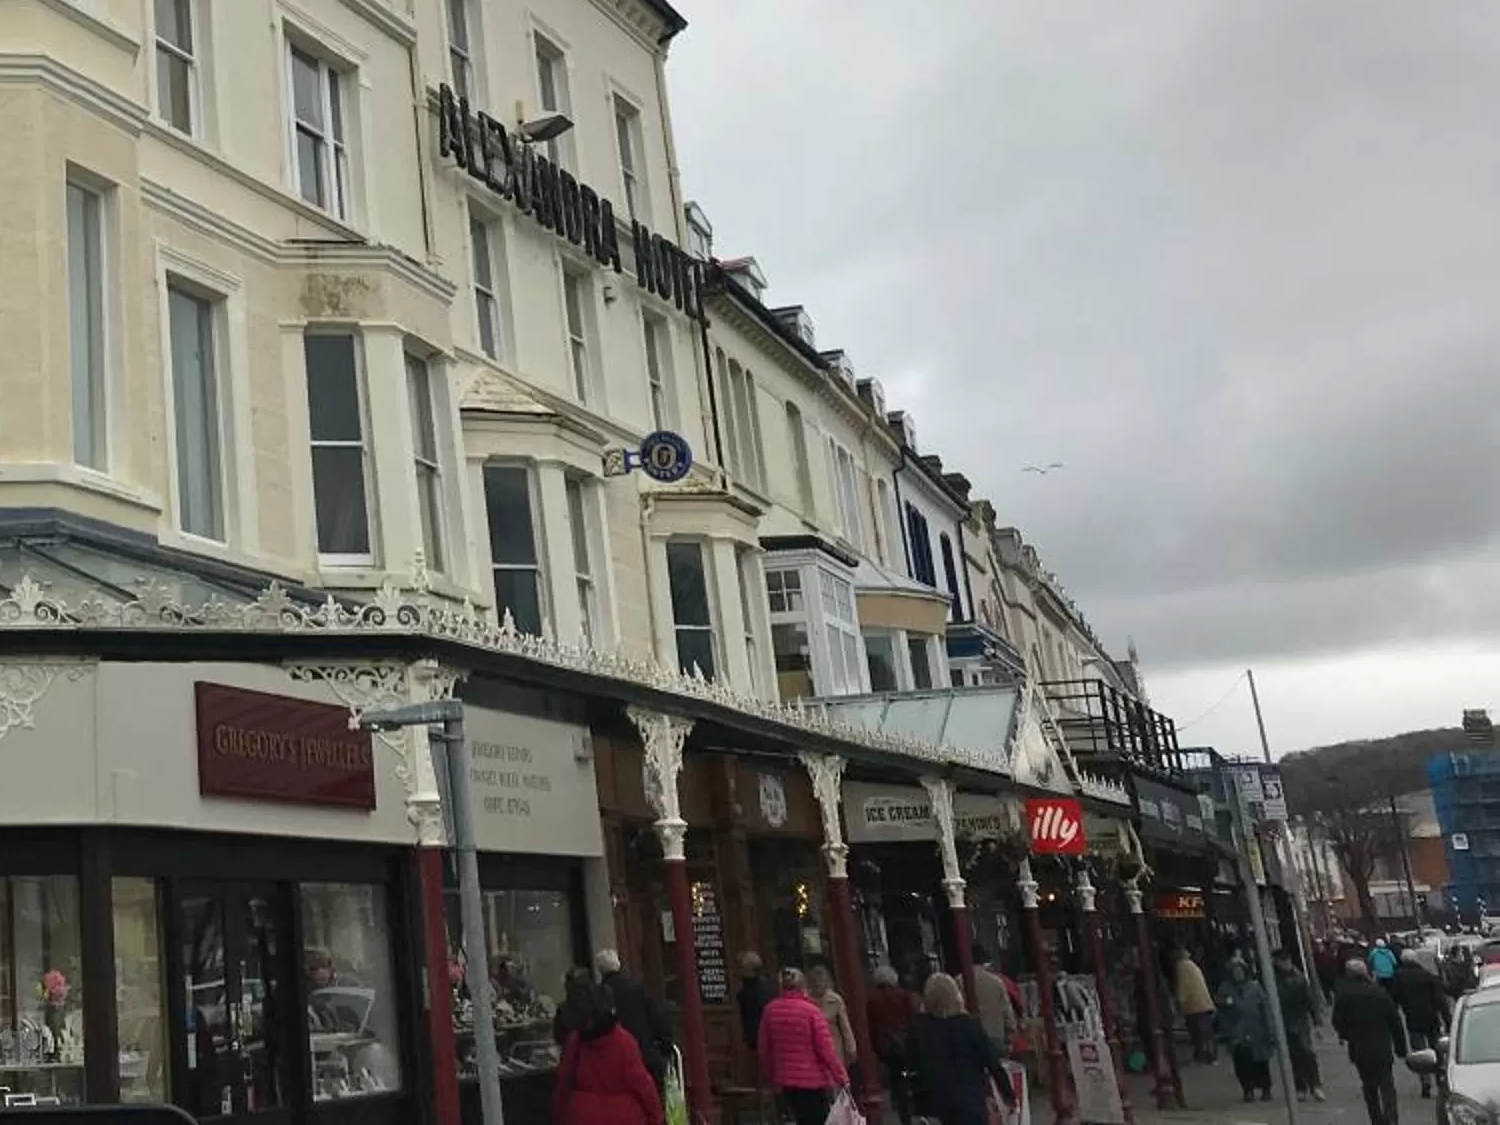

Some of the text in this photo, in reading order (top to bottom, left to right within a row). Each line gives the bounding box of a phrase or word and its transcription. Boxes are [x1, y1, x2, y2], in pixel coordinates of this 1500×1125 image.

[865, 806, 887, 822] ICE
[1032, 806, 1078, 848] illy
[1178, 895, 1205, 908] KF
